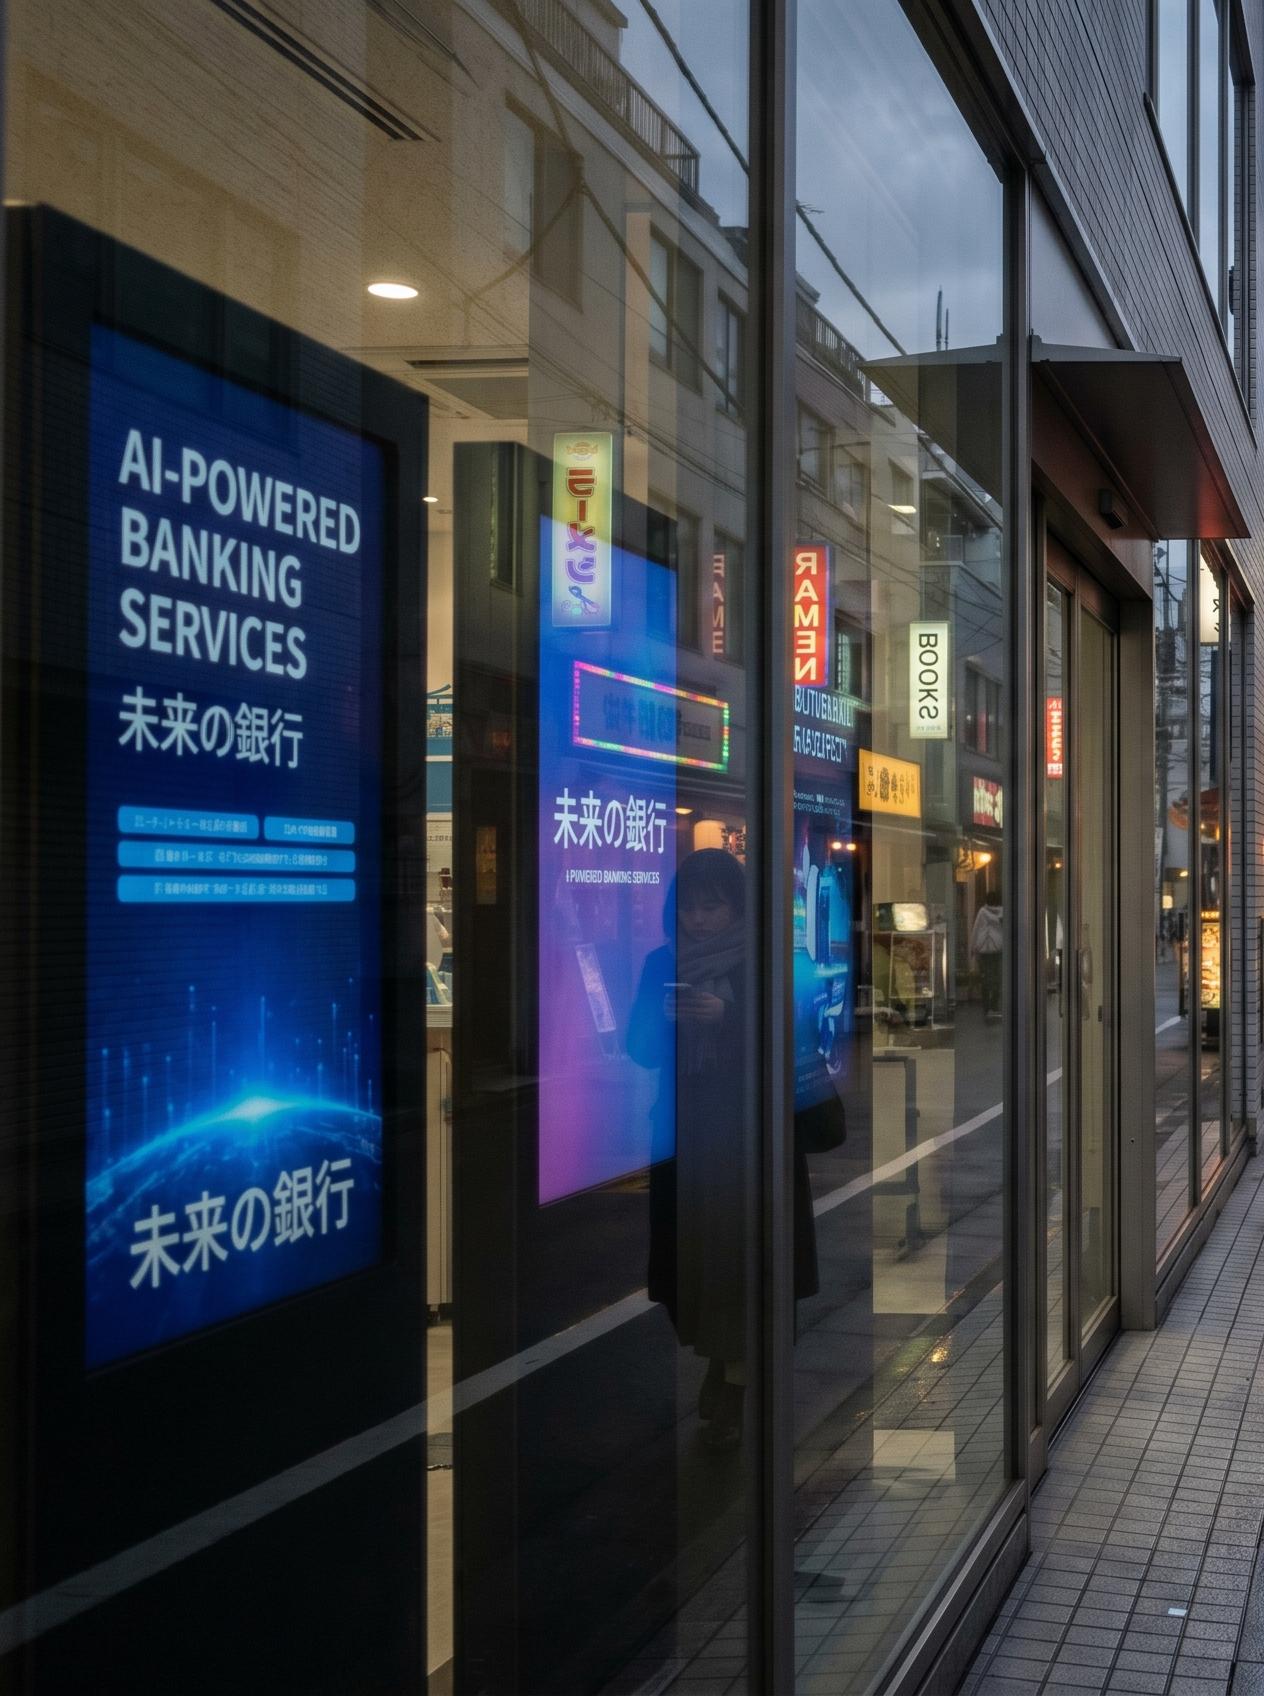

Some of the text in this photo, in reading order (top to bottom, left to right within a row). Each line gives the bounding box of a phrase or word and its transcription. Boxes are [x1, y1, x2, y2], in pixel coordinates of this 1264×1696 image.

[118, 428, 361, 555] AI-POWERED
[121, 507, 302, 608] BANKING
[119, 588, 308, 680] SERVICES
[118, 686, 304, 769] 未来の銀行
[553, 787, 667, 854] 未来の銀行
[130, 1157, 355, 1290] 未来の銀行
